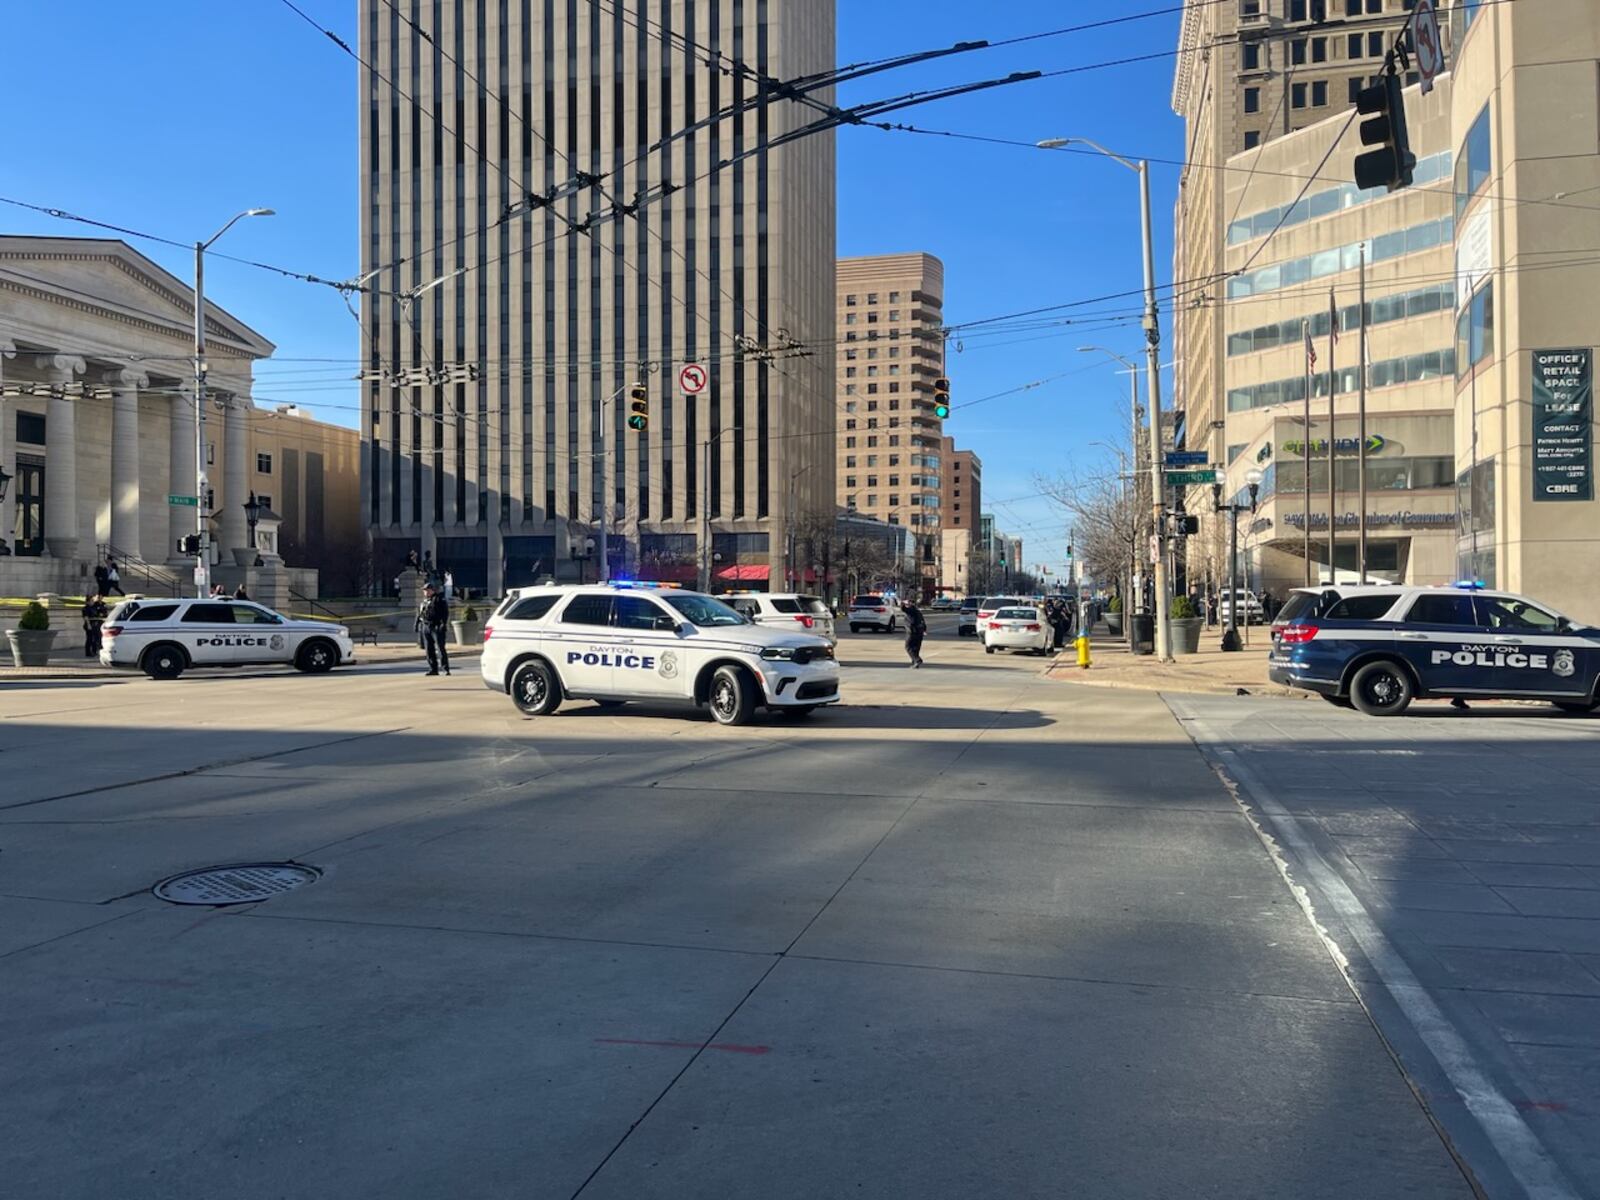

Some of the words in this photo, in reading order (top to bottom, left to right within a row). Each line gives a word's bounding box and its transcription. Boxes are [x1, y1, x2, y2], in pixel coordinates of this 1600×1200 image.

[1539, 355, 1579, 364] OFFICE
[1543, 367, 1581, 375] RETAIL
[1544, 379, 1580, 387] SPACE
[1544, 403, 1580, 412] LEASE
[1543, 424, 1580, 432] CONTACT
[1545, 484, 1578, 493] CBRE
[1284, 512, 1320, 525] DAYTN
[196, 638, 267, 647] POLICE
[589, 645, 634, 654] DAYTON
[1461, 644, 1520, 653] DAYTON
[566, 651, 656, 670] POLICE
[1431, 650, 1548, 669] POLICE
